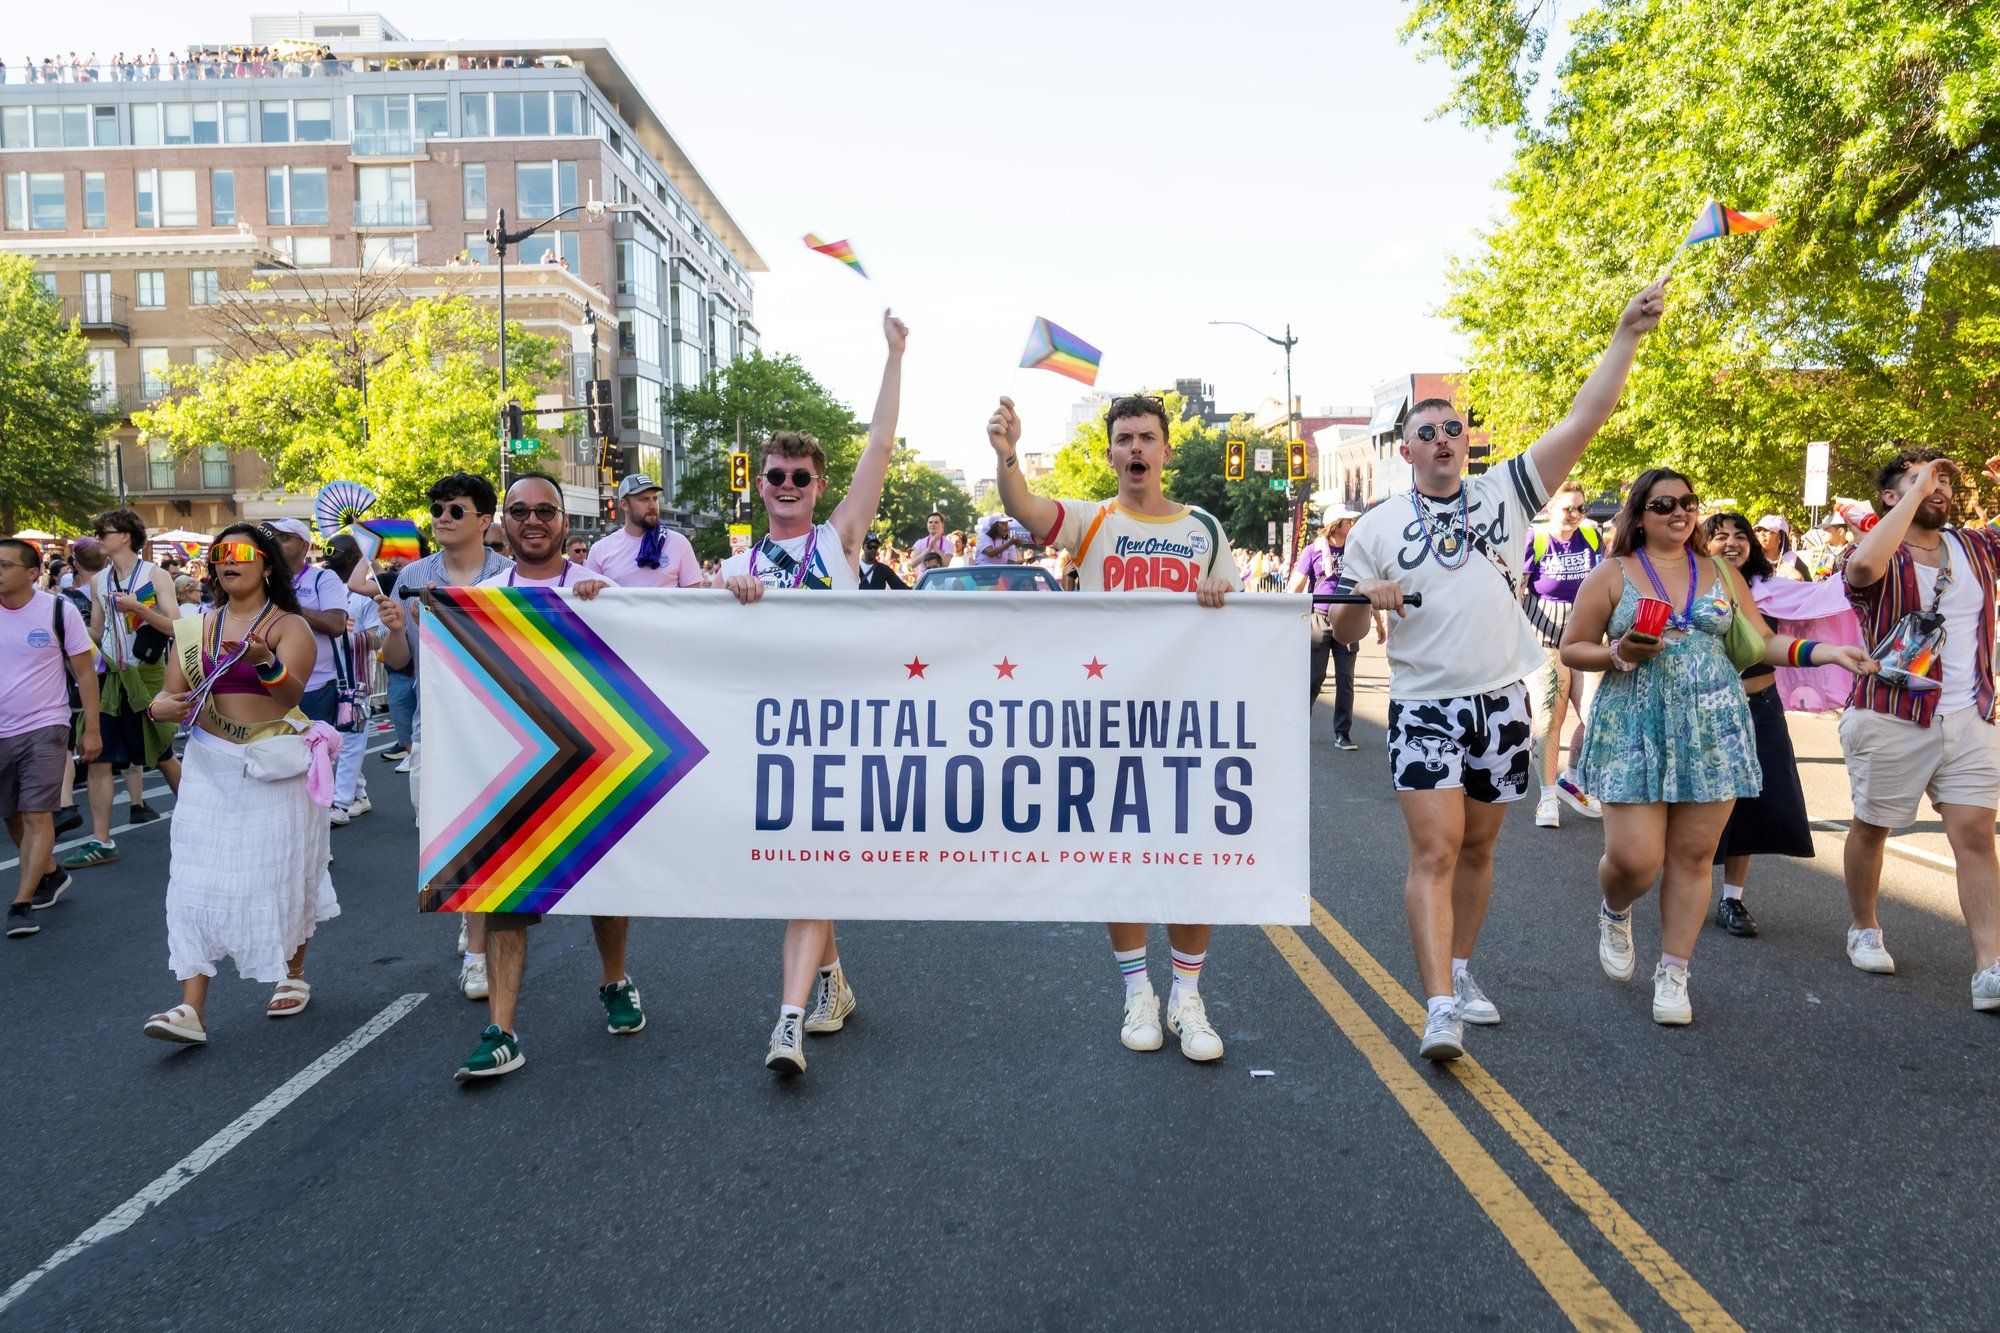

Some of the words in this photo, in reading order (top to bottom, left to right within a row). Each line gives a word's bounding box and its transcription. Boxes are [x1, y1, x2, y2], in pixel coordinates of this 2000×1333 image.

[515, 440, 522, 449] S
[1115, 536, 1145, 557] New
[1145, 537, 1194, 559] Orleans
[1103, 555, 1200, 593] PRIDE
[184, 644, 203, 688] BIRTH
[755, 697, 947, 748] CAPITAL
[968, 699, 1257, 750] STONEWALL
[755, 753, 1253, 836] DEMOCRATS
[751, 849, 852, 862] BUILDING
[861, 850, 929, 864] QUEER
[939, 850, 1050, 863] POLITICAL
[1060, 851, 1132, 864] POWER
[1142, 852, 1203, 865] SINCE
[1212, 853, 1256, 866] 1976
